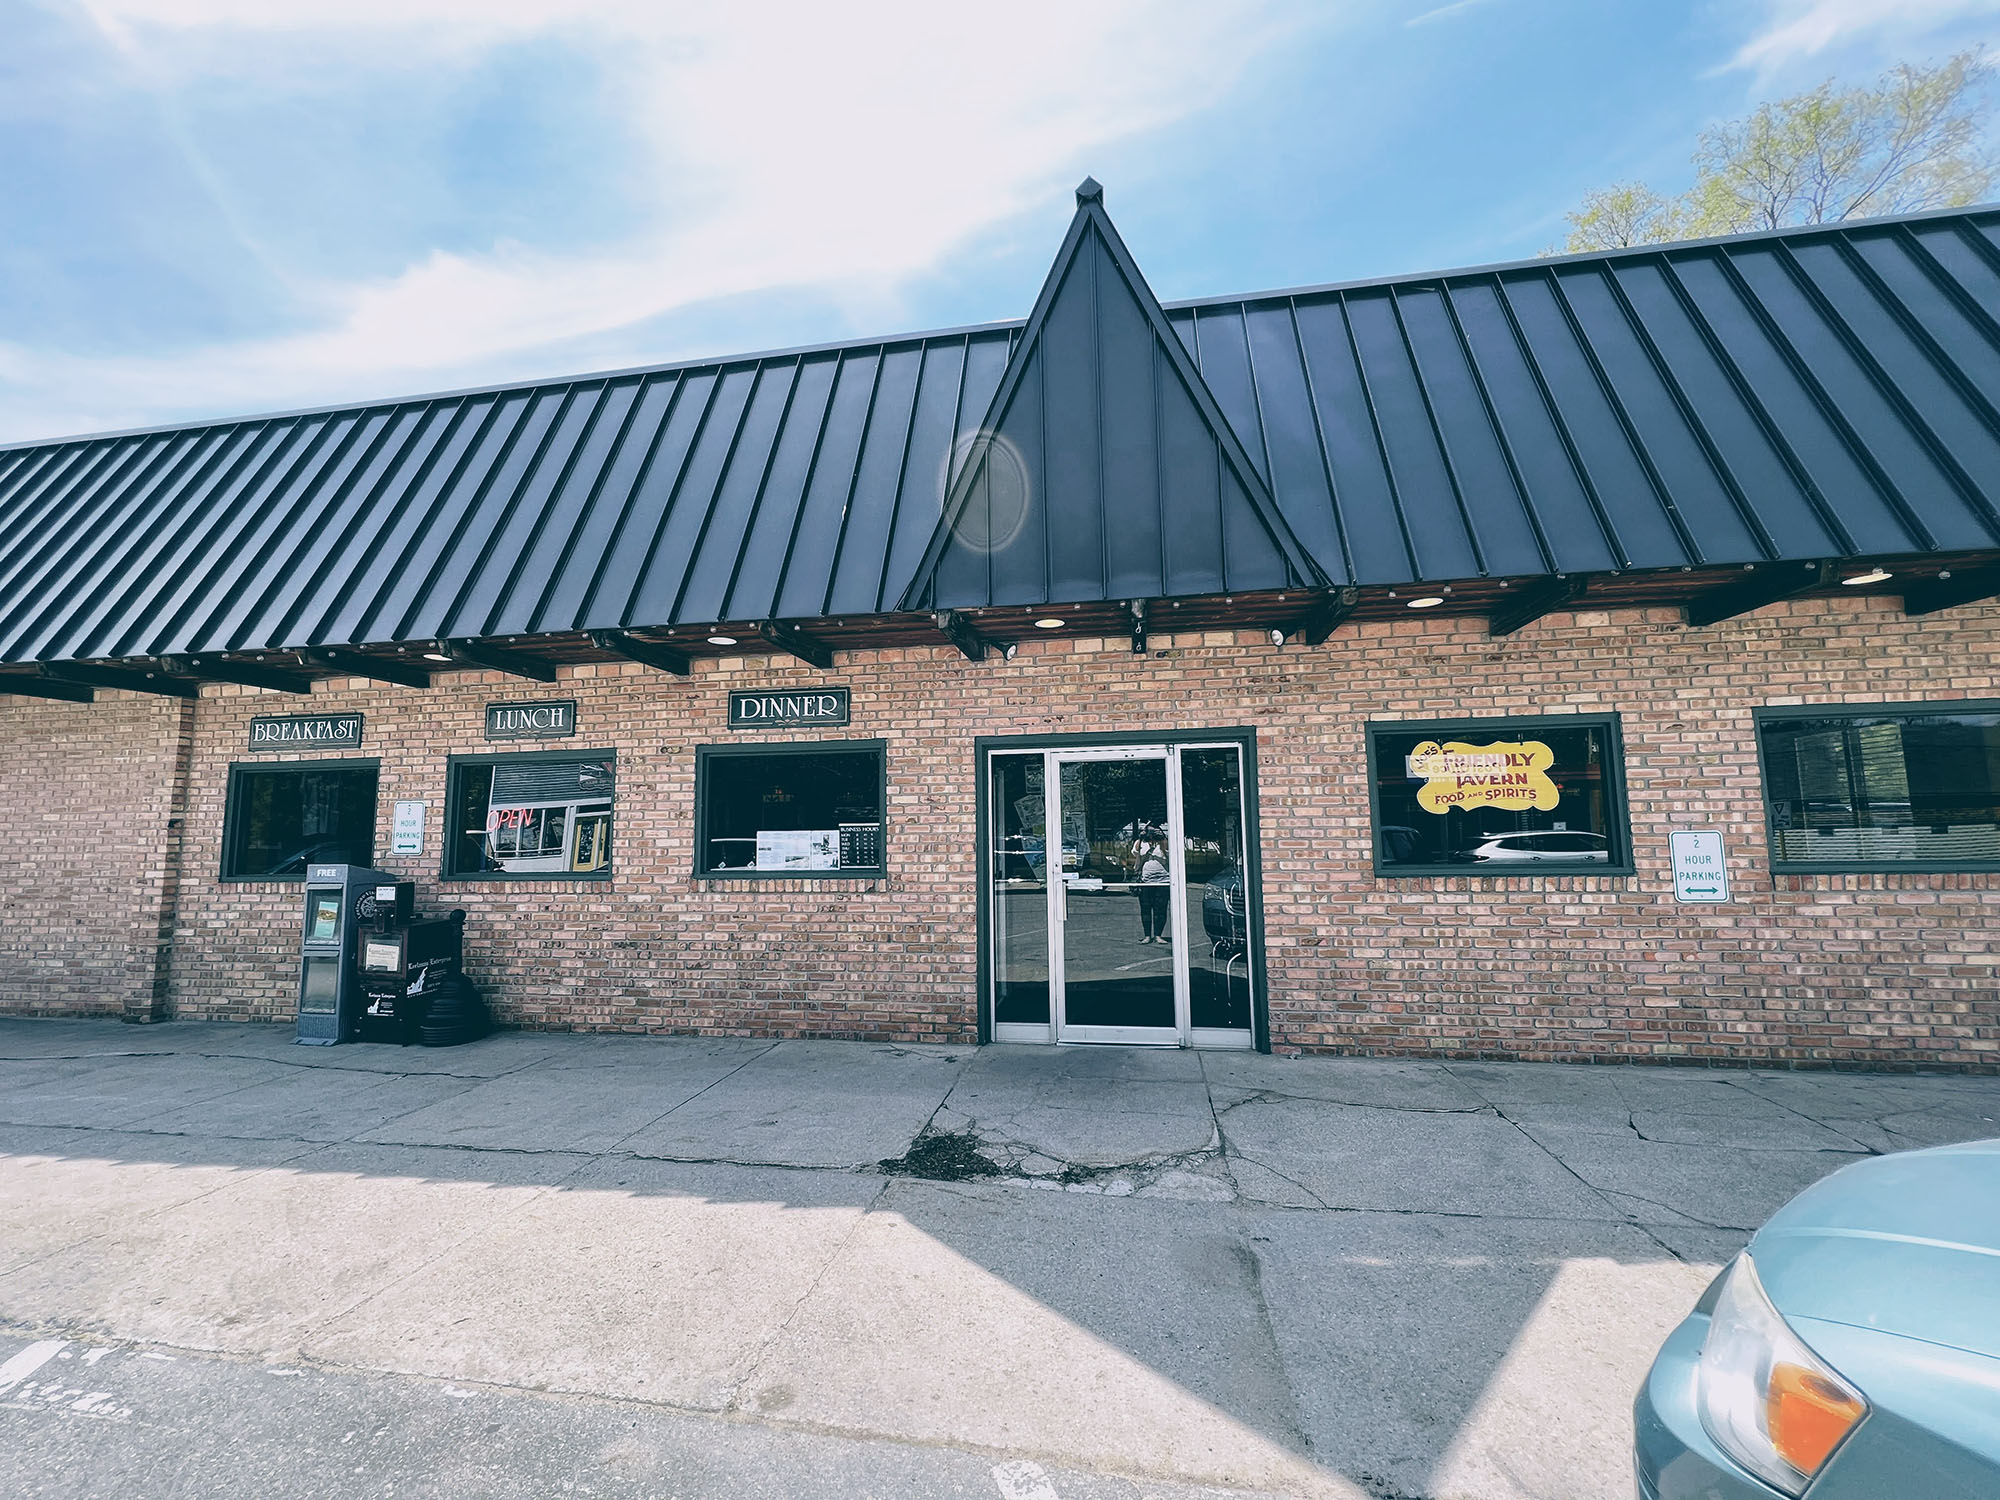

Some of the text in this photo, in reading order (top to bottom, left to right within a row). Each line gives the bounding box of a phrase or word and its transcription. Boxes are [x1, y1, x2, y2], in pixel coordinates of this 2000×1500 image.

[739, 695, 838, 719] DINNER
[494, 707, 565, 730] LUNCH
[253, 719, 357, 742] BREAKFAST
[1442, 749, 1536, 769] FRIENDLY
[1455, 772, 1528, 789] TAVERN
[1434, 788, 1537, 805] FOOD AND SPIRITS
[407, 807, 412, 815] 2
[400, 819, 417, 827] HOUR
[486, 807, 534, 832] OPEN
[396, 831, 420, 839] PARKING
[1693, 839, 1700, 849] 2
[1684, 855, 1712, 865] HOUR
[316, 868, 337, 877] FREE
[1679, 871, 1721, 881] PARKING
